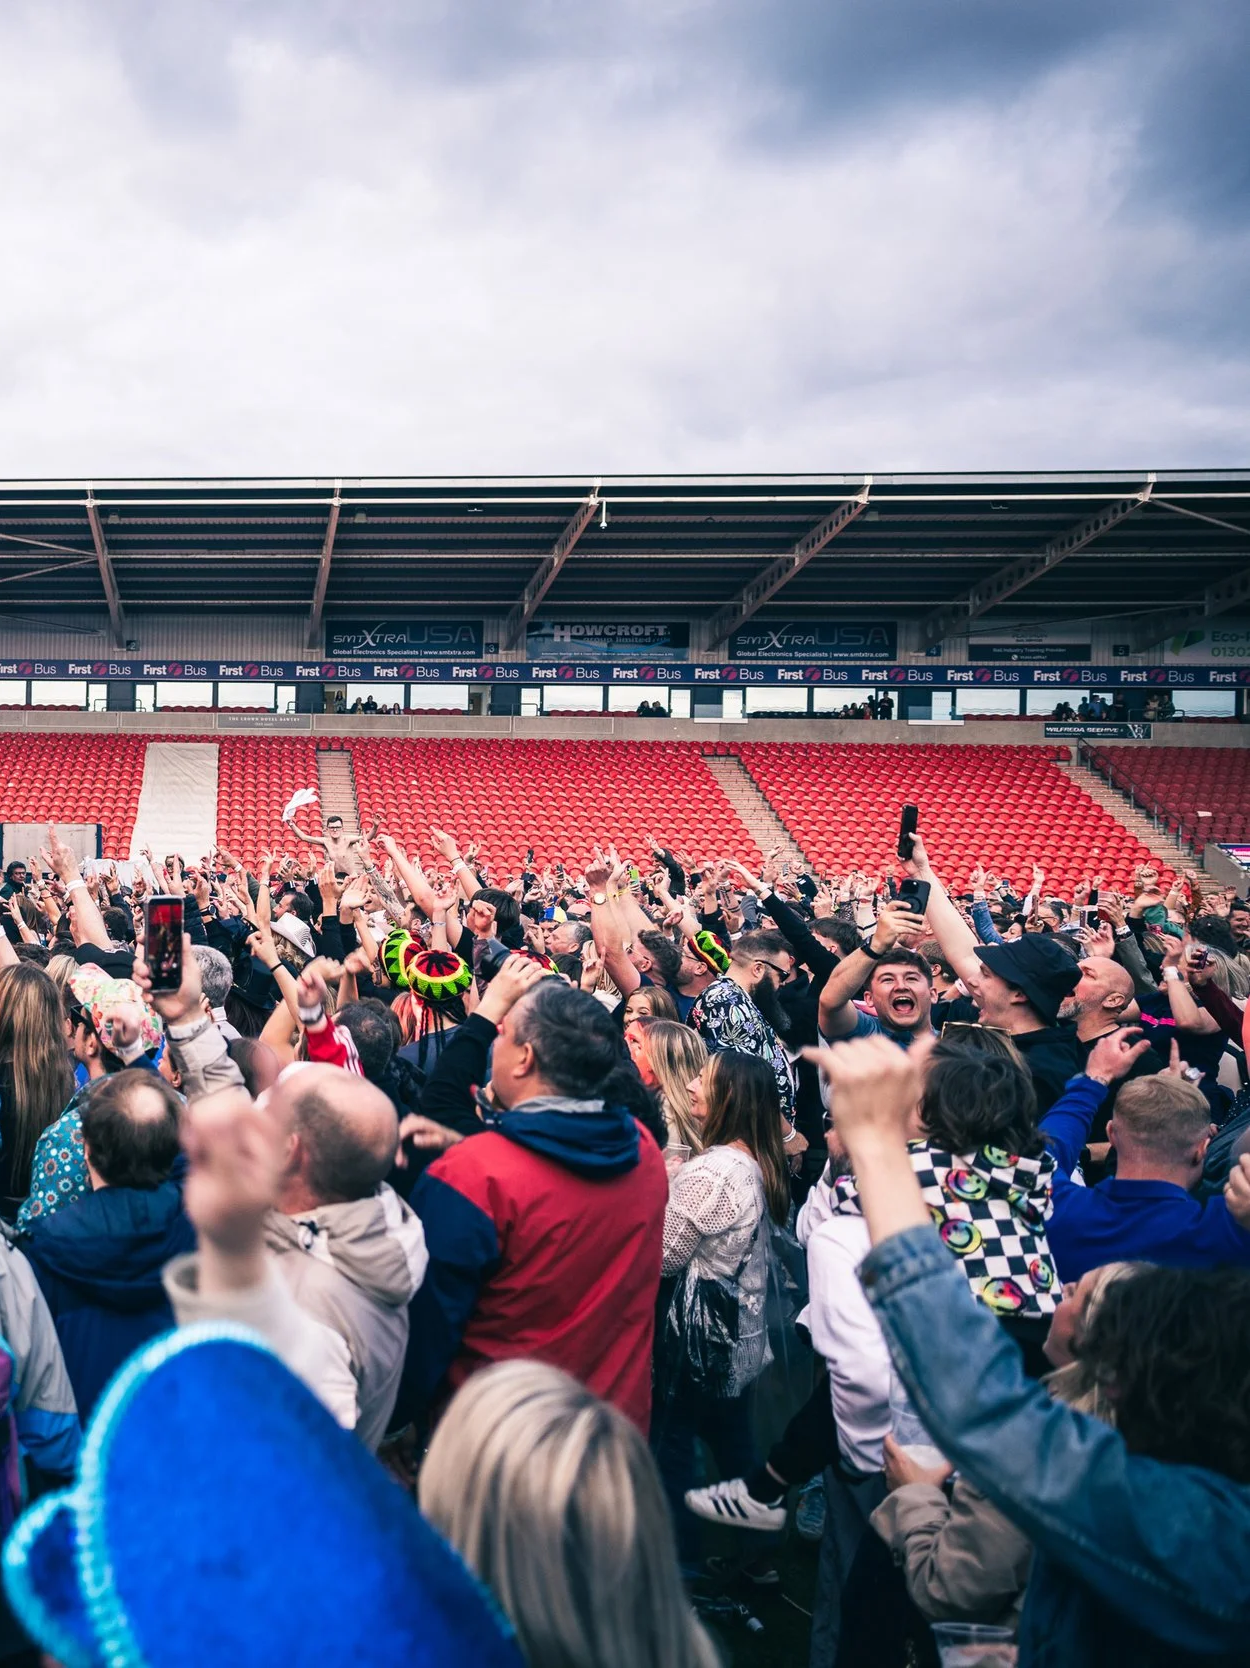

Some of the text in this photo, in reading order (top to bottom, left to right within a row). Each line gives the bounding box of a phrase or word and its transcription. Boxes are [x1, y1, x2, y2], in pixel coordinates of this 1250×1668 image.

[553, 624, 668, 643] HOWCROFT
[615, 635, 652, 643] limited
[130, 641, 136, 650] 2
[488, 644, 495, 653] 3
[930, 646, 937, 655] 4
[1118, 646, 1125, 655] 5
[794, 650, 829, 658] Specialists
[35, 664, 56, 674] Bus
[69, 664, 131, 675] First Bus
[144, 664, 207, 675] First Bus
[220, 665, 283, 676] First Bus
[296, 666, 361, 677] First Bus
[374, 666, 439, 677] First Bus
[453, 667, 519, 678] First Bus
[532, 667, 599, 678] First Bus
[613, 668, 681, 679] First Bus
[695, 668, 763, 680] First Bus
[778, 669, 847, 680] First Bus
[862, 670, 932, 680] First Bus
[948, 670, 1019, 681] First Bus
[1034, 671, 1106, 681] First Bus
[1121, 671, 1194, 682] First Bus
[1210, 672, 1236, 681] First
